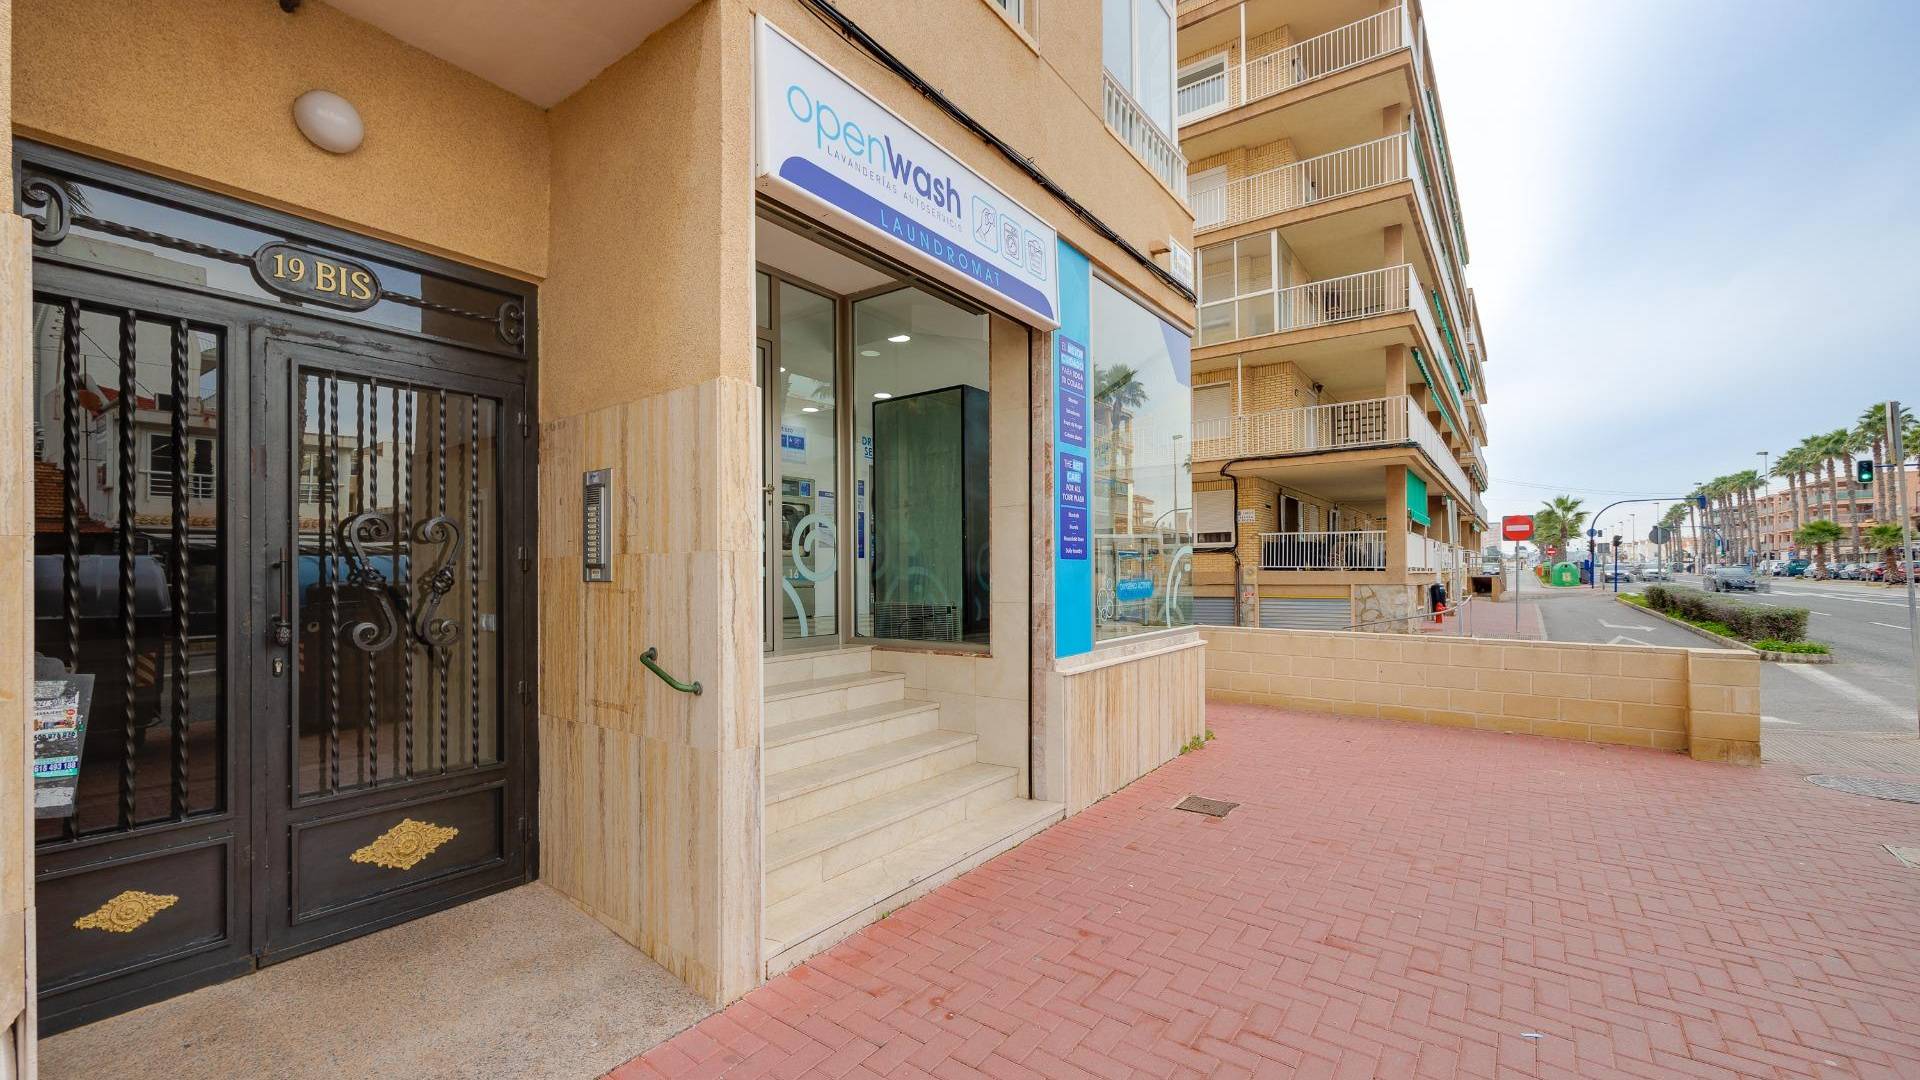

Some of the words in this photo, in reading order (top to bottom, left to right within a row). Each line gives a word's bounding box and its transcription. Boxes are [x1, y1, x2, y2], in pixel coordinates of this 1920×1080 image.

[903, 191, 963, 233] AUTOSERVICIO
[880, 209, 1000, 287] LAUNDROMAT
[273, 254, 305, 282] 19
[315, 261, 371, 300] BIS
